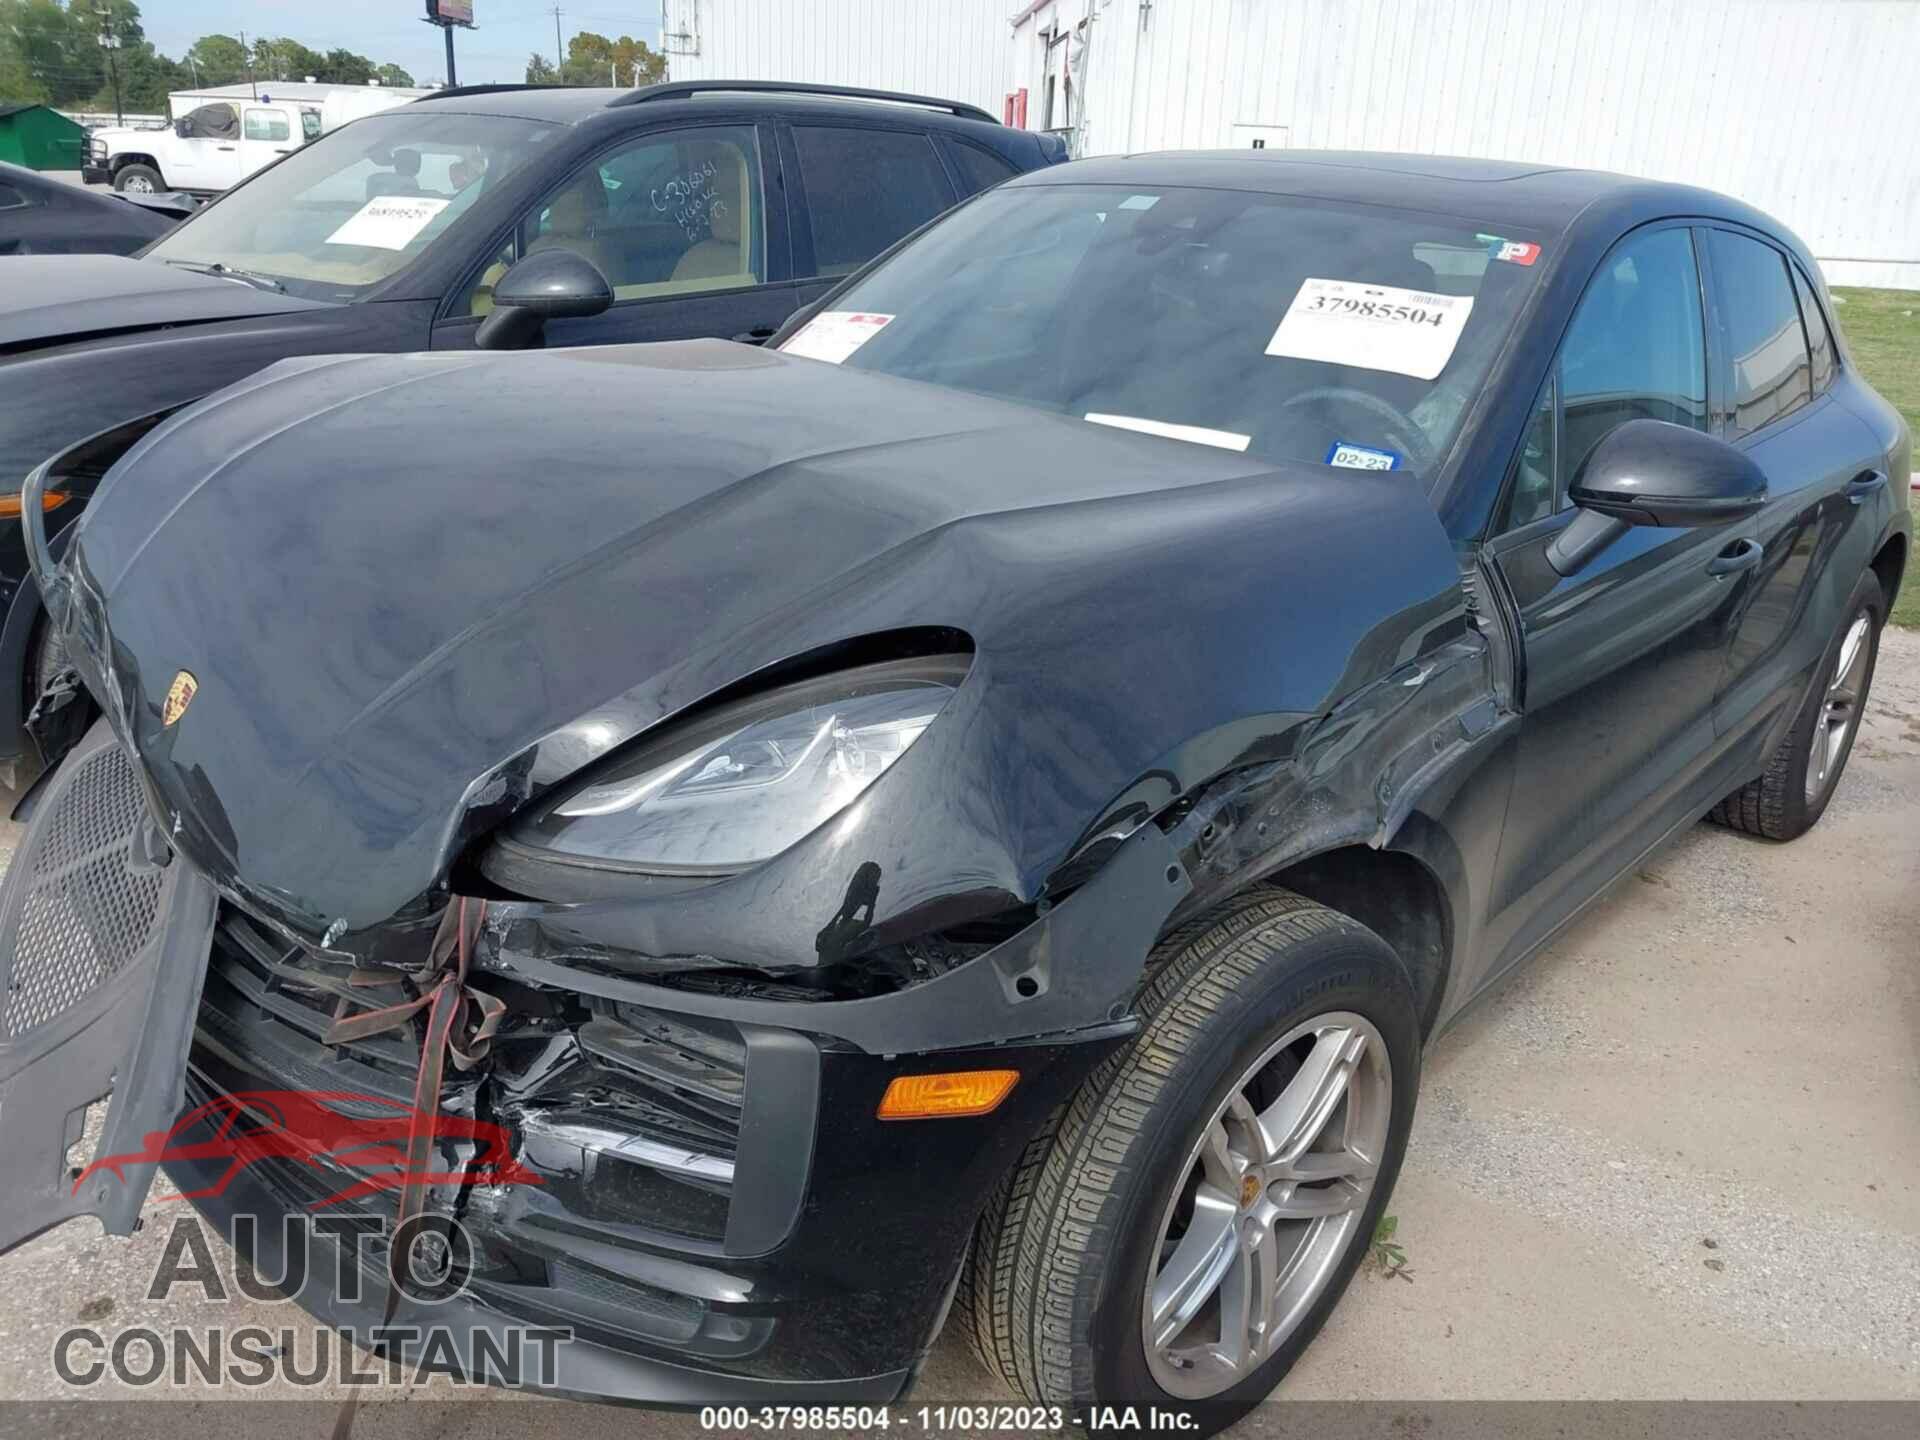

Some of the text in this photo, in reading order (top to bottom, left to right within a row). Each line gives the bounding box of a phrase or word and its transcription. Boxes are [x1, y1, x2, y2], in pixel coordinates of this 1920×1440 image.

[1307, 296, 1445, 328] 37985504
[1336, 452, 1389, 471] 02 23
